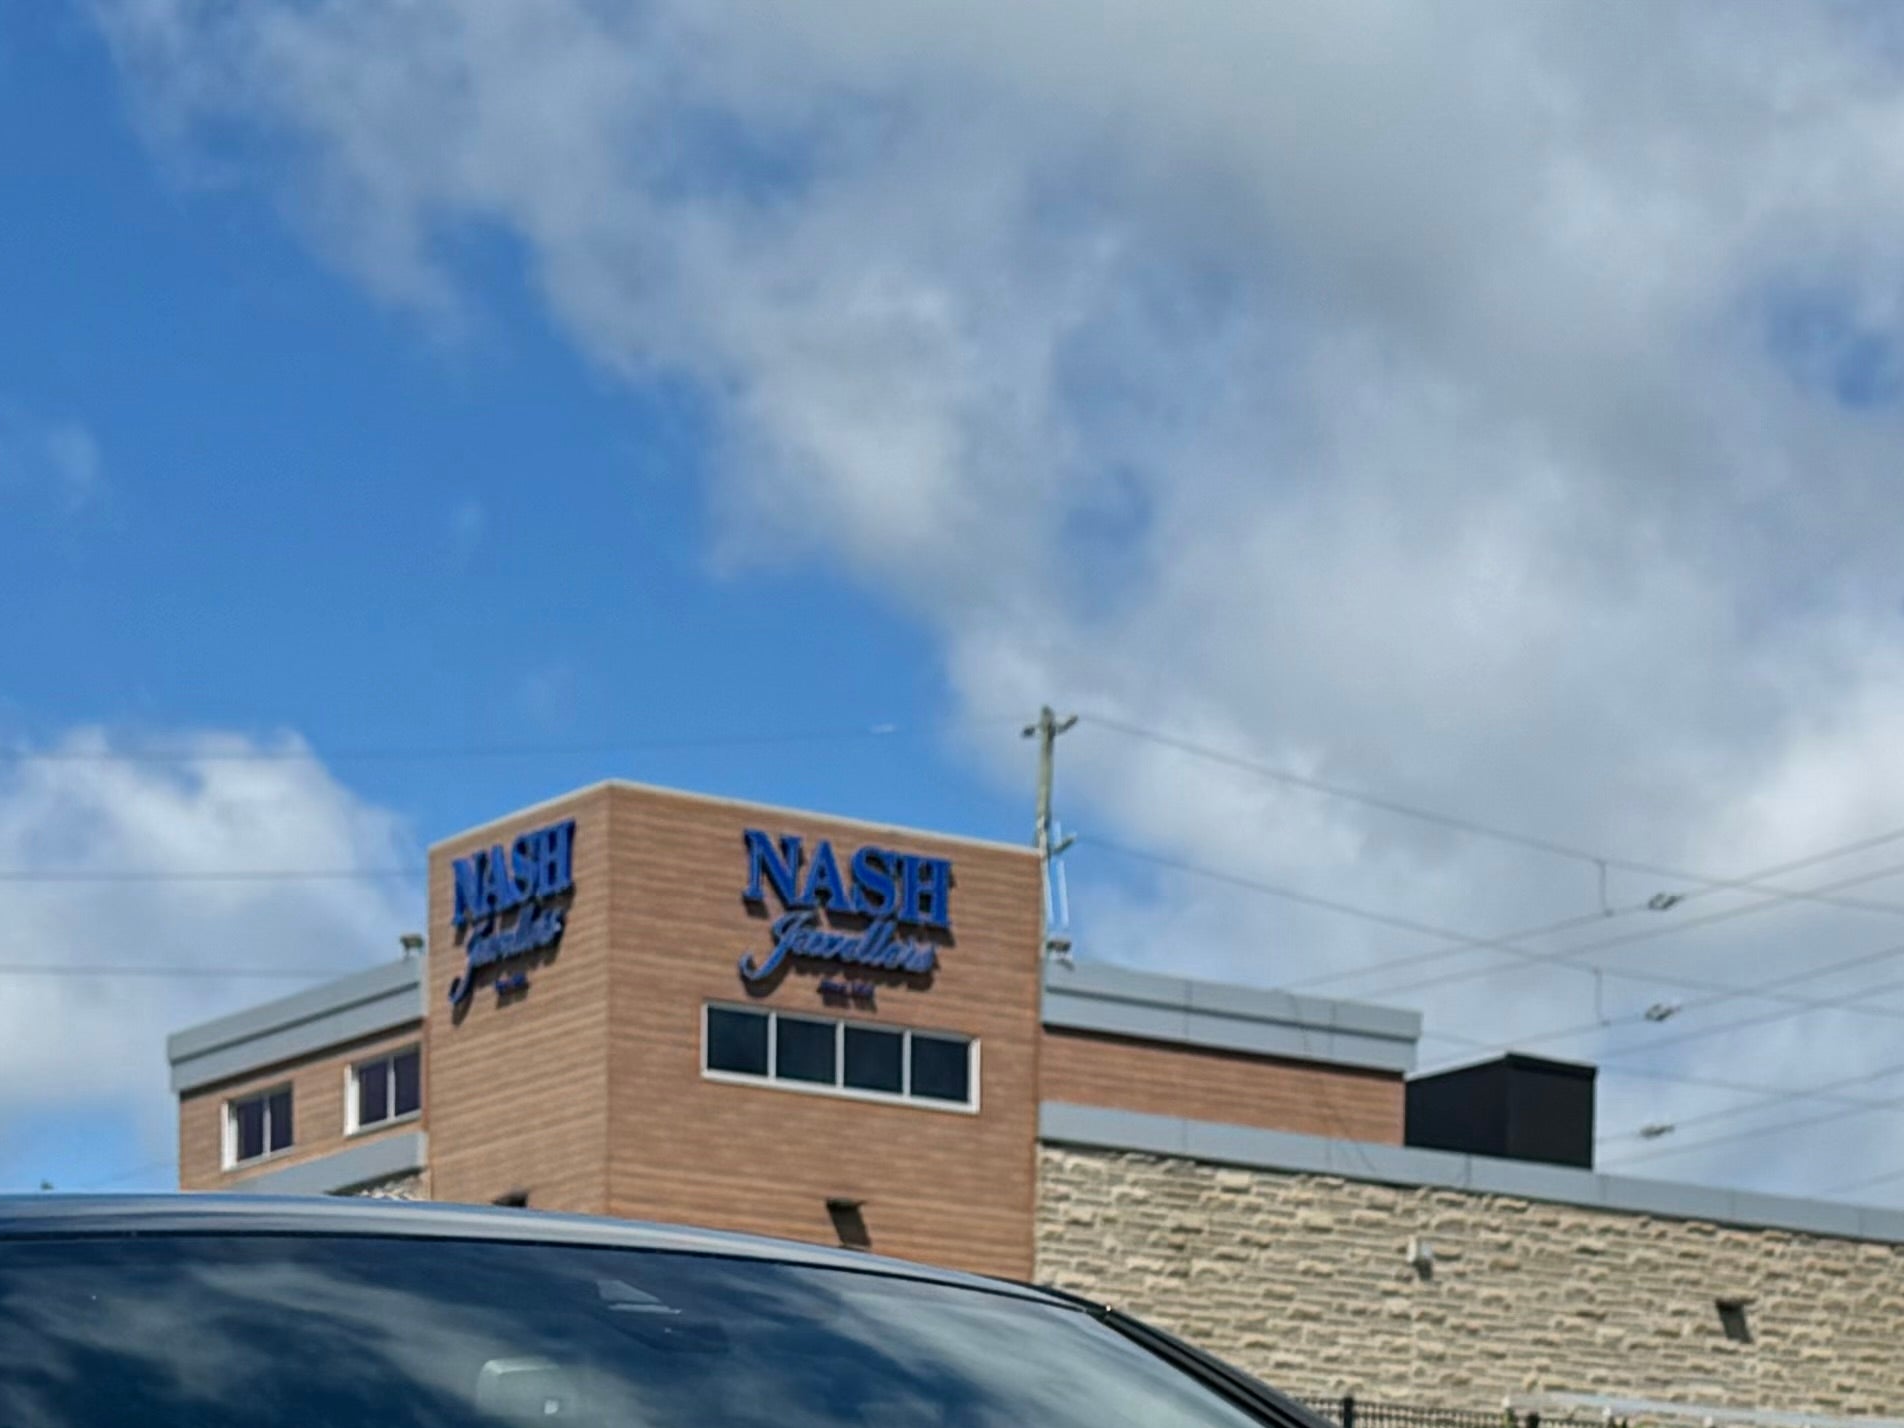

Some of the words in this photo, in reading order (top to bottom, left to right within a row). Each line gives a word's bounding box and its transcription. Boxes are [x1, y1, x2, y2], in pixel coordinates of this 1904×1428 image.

[451, 819, 575, 924] NASH
[744, 829, 951, 928] NASH
[739, 910, 936, 980] Jewellers
